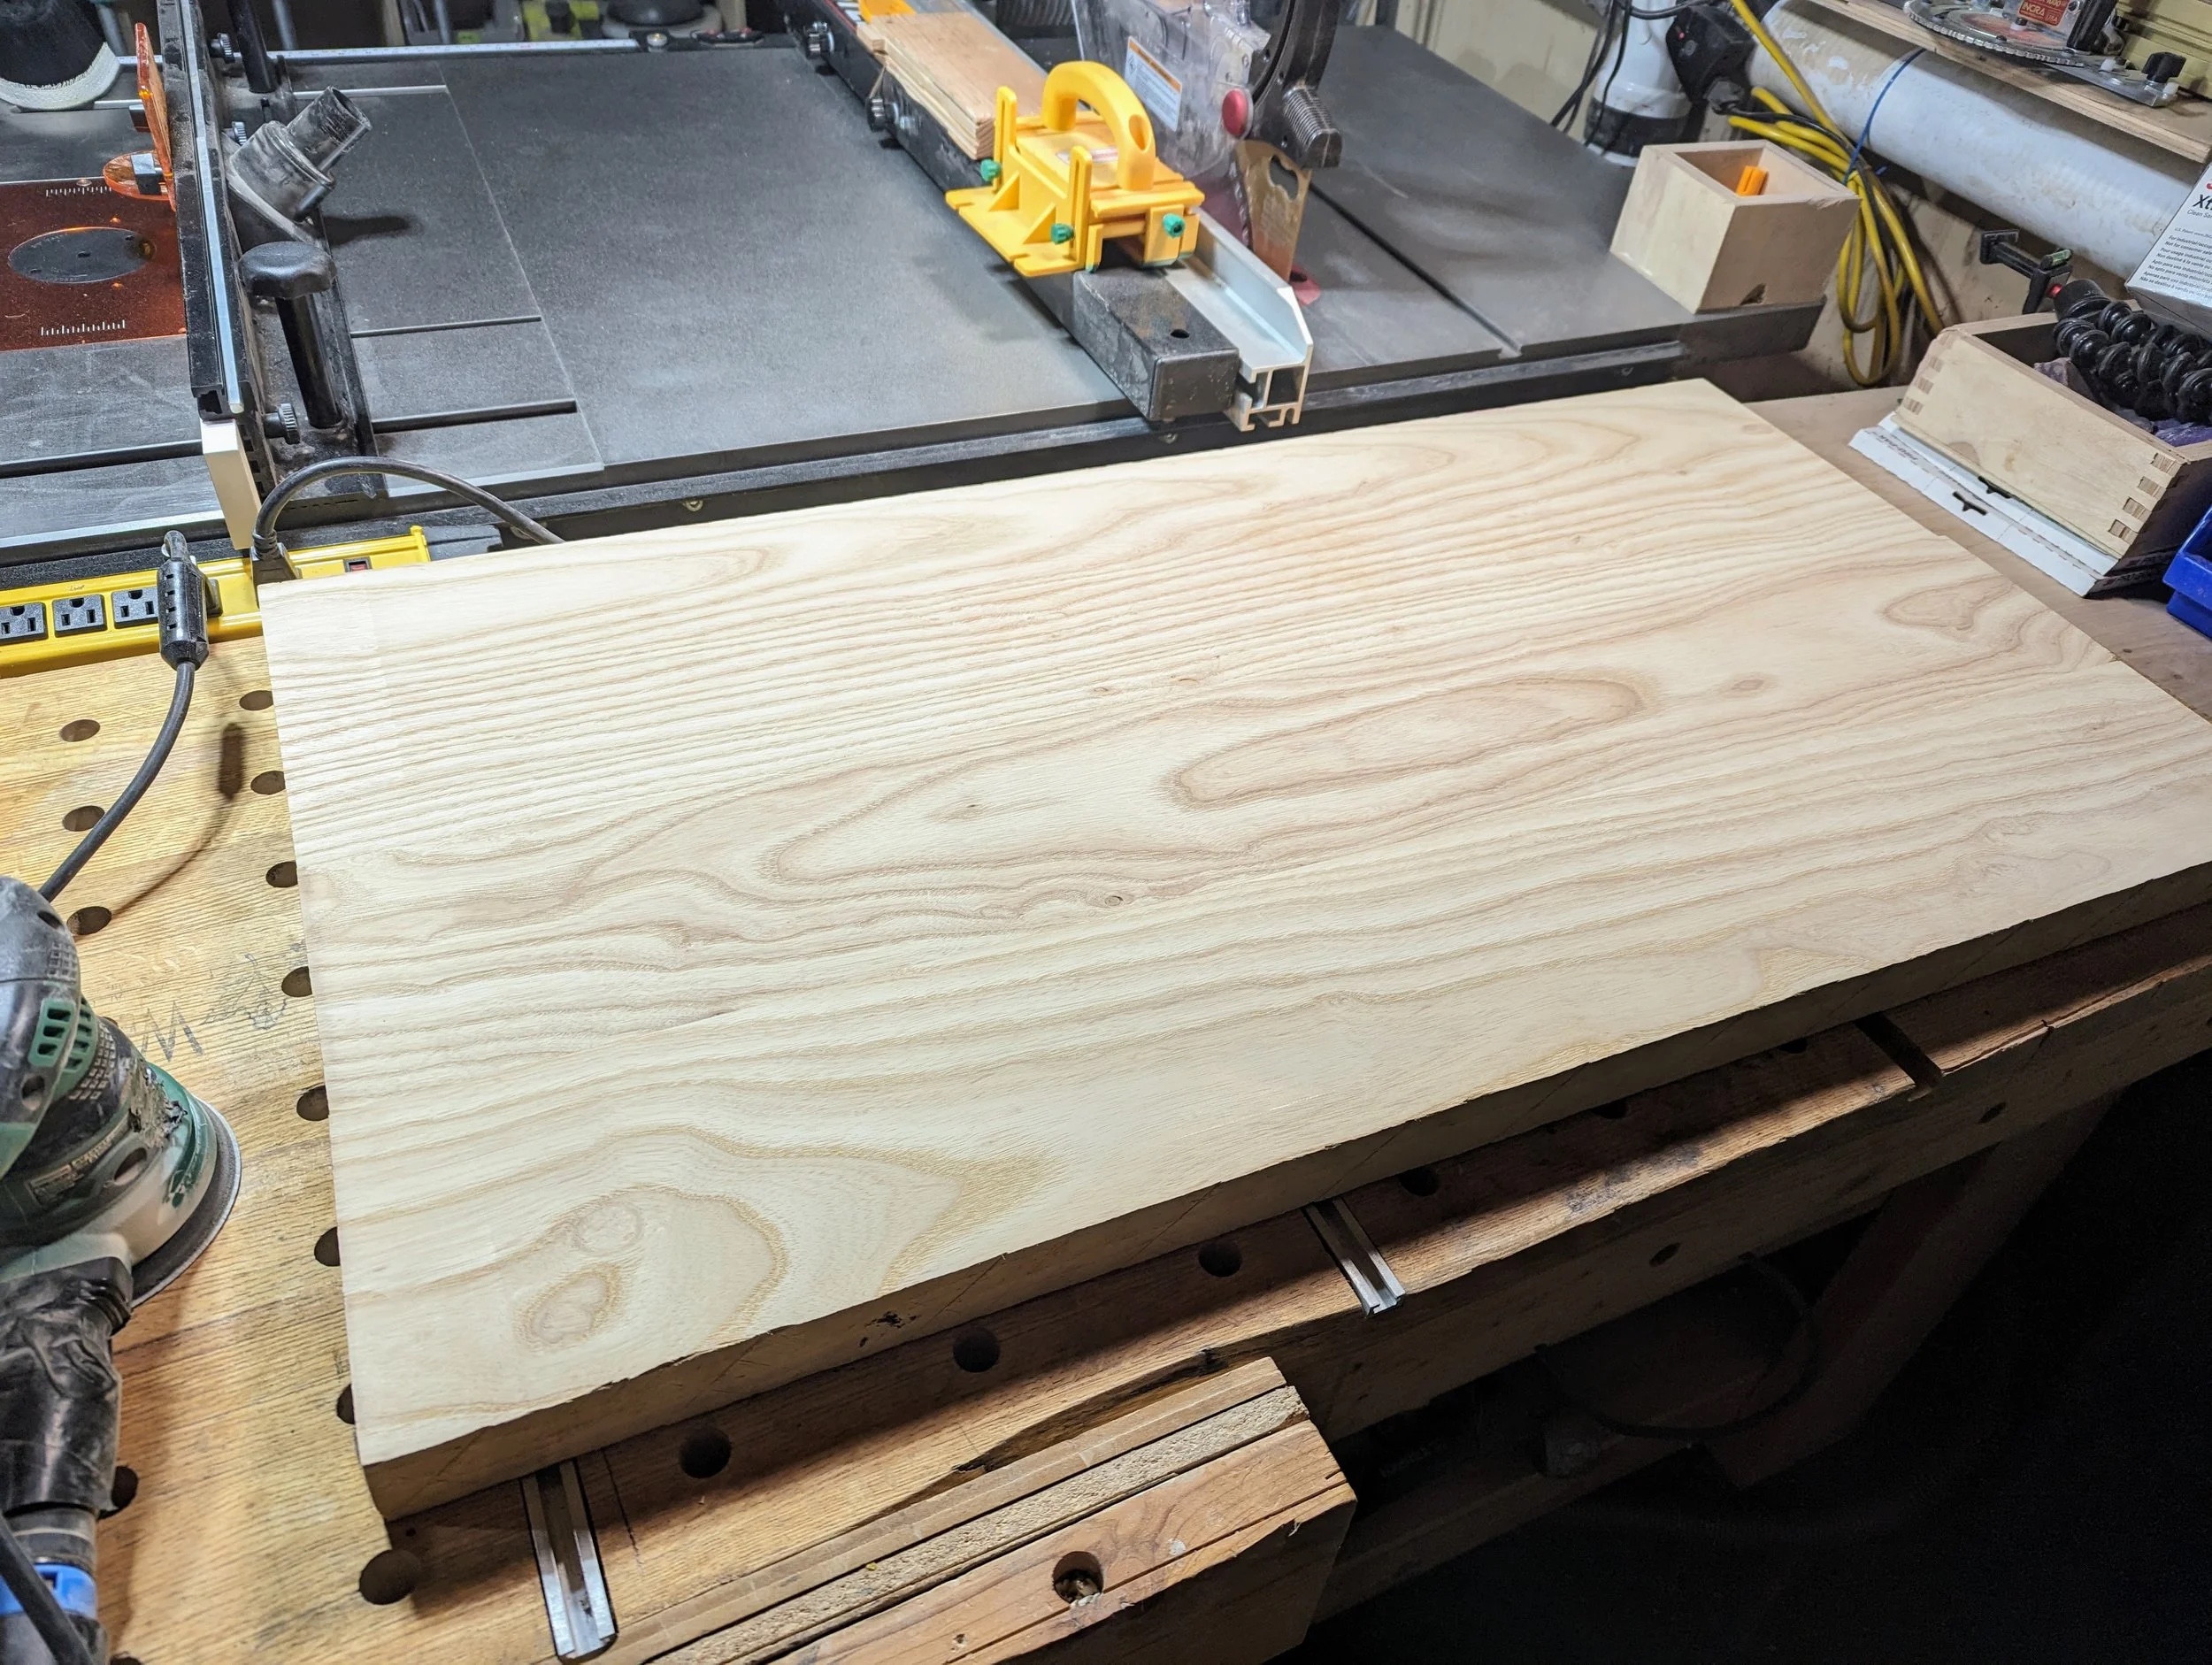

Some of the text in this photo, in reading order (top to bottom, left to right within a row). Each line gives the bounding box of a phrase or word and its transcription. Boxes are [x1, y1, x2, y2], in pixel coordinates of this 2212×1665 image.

[2022, 3, 2046, 17] INCRA
[2193, 194, 2212, 211] Xt
[2184, 252, 2206, 262] industrial
